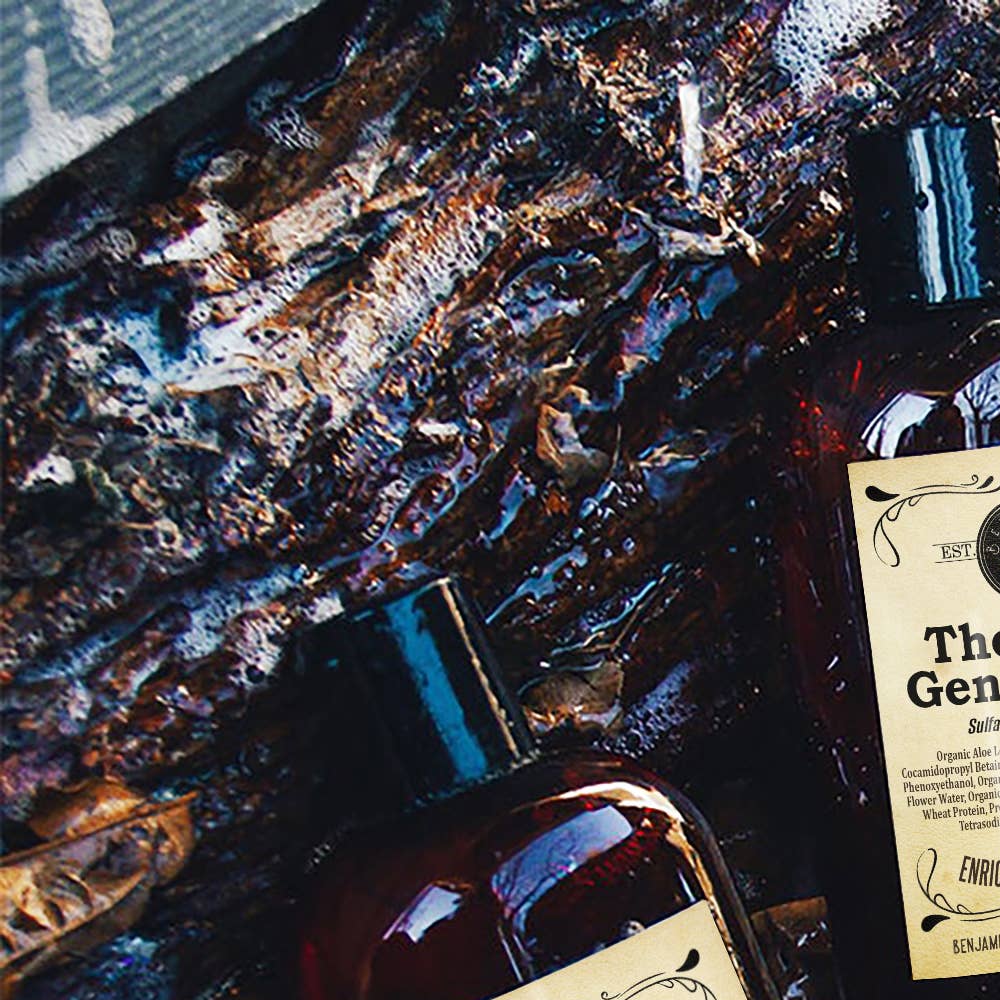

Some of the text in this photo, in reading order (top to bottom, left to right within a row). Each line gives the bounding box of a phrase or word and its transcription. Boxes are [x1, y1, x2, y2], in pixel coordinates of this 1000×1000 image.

[937, 749, 970, 763] Organic
[973, 747, 991, 758] Aloe
[902, 762, 973, 778] Cocamidopropyl
[903, 776, 976, 793] Phenoxyethanol,
[907, 796, 937, 807] Flower
[938, 794, 966, 805] Water,
[968, 789, 1000, 803] Organic
[923, 808, 951, 820] Wheat
[953, 805, 988, 818] Protein,
